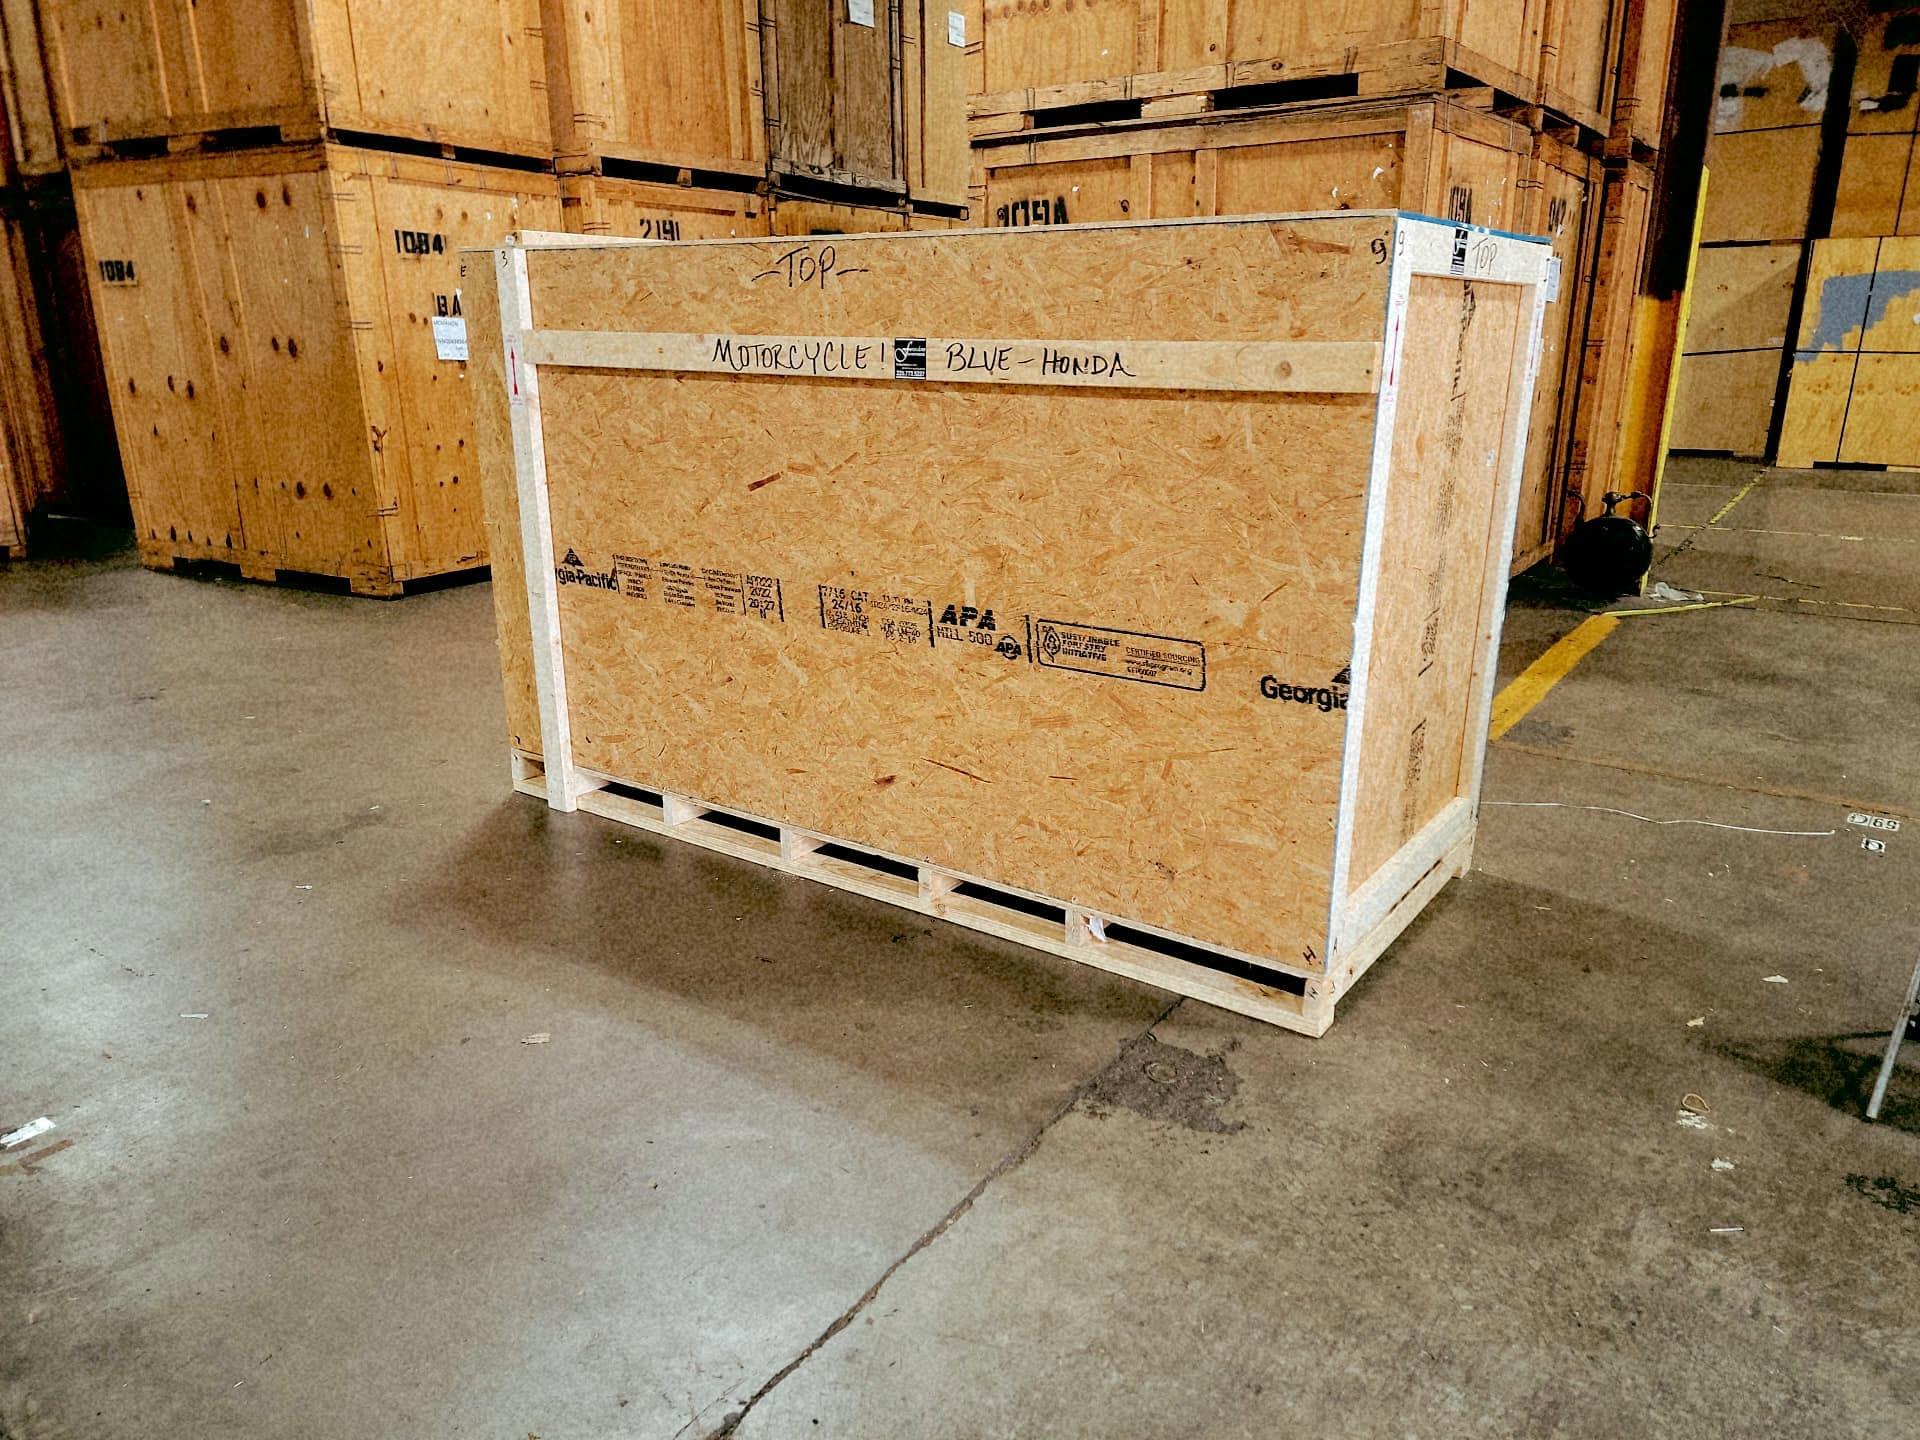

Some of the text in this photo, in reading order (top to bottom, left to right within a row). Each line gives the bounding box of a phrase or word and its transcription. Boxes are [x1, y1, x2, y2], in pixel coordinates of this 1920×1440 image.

[1471, 237, 1498, 275] TOP
[555, 566, 617, 590] gia-Pacific
[939, 604, 996, 631] APA
[968, 630, 993, 645] 500
